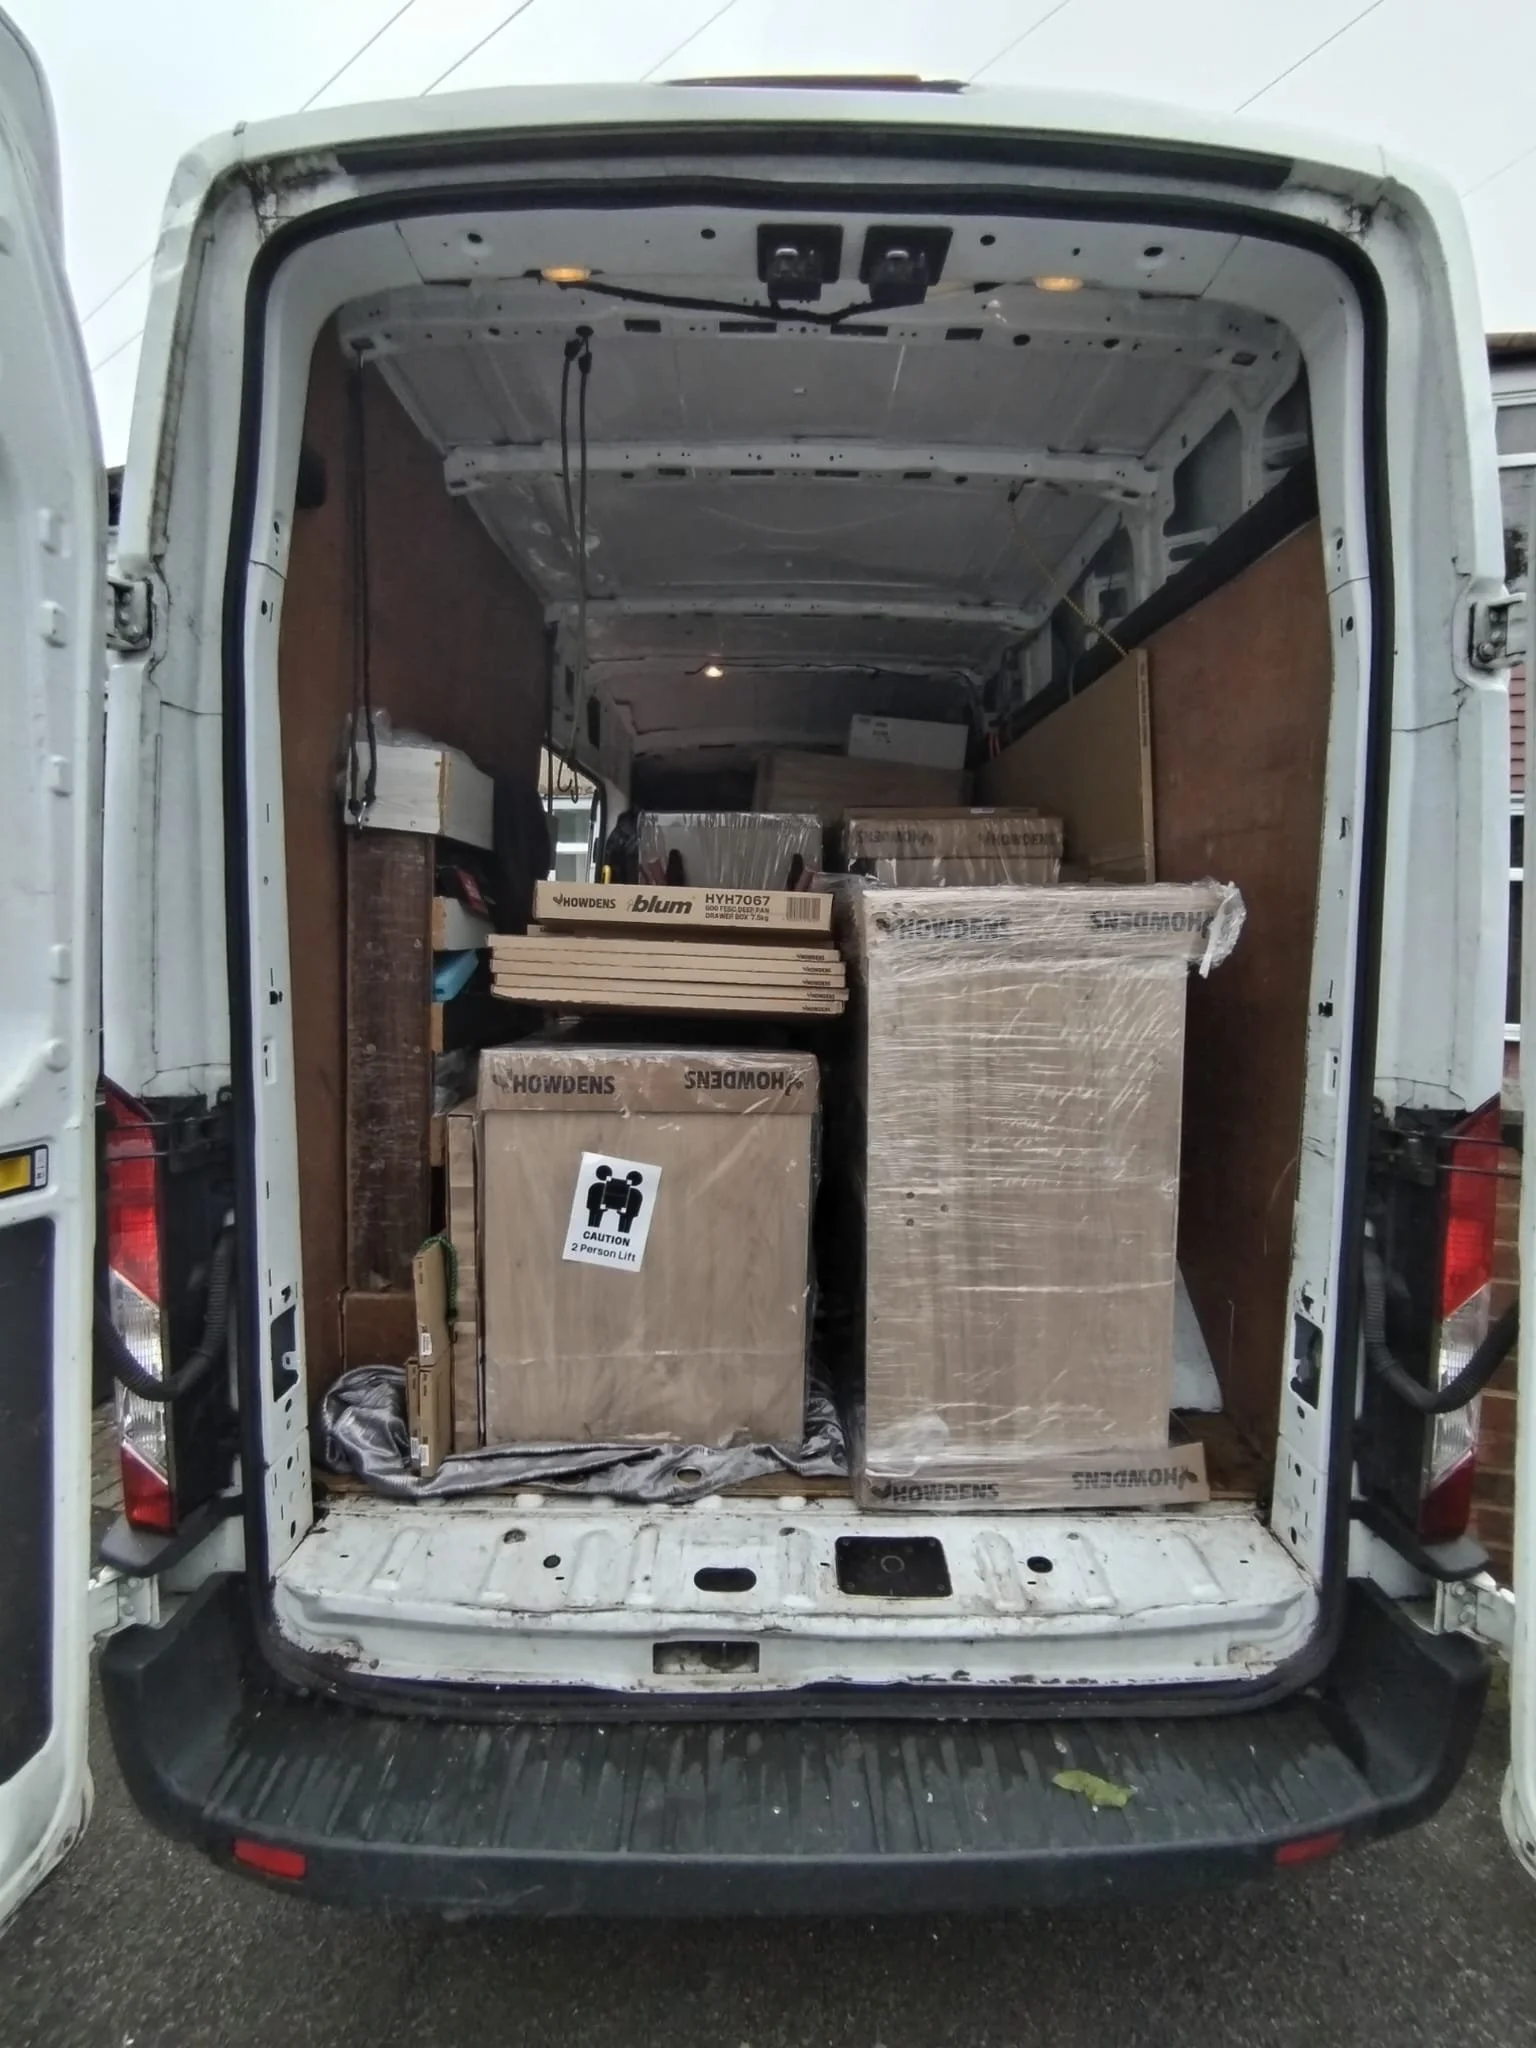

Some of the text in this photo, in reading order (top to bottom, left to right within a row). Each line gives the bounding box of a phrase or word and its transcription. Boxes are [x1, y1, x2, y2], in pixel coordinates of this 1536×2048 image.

[563, 897, 617, 910] HOWDENS
[631, 894, 694, 915] blum
[705, 893, 771, 907] HYH7067
[705, 912, 734, 920] DRAWER
[735, 913, 749, 921] BOX
[738, 906, 755, 914] DEEP
[755, 907, 770, 915] PAN
[512, 1073, 616, 1095] HOWDENS
[684, 1069, 785, 1091] HOWDENS
[582, 1230, 631, 1247] CAUTION
[571, 1242, 636, 1262] 2 Person Lift
[1072, 1466, 1178, 1490] HOWDENS
[892, 1482, 1000, 1502] HOWDENS
